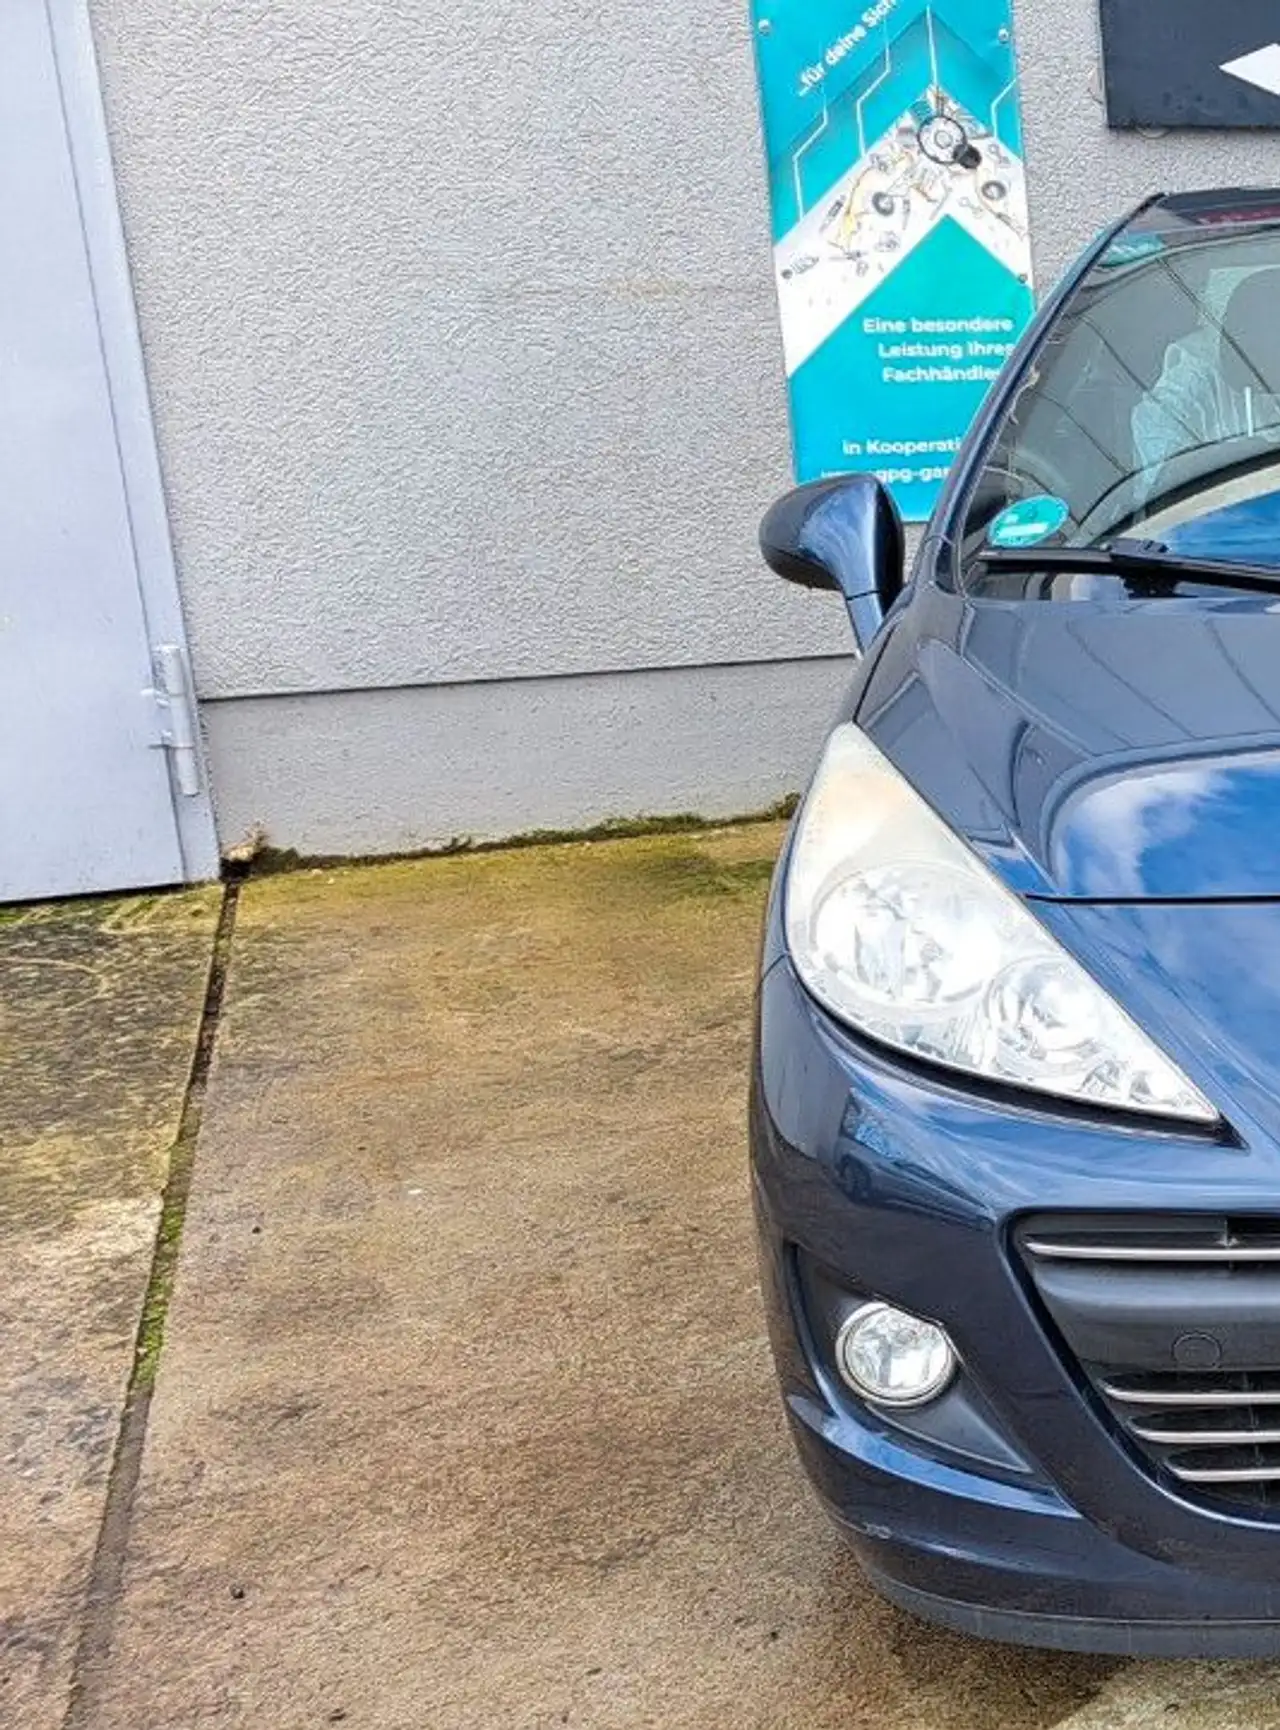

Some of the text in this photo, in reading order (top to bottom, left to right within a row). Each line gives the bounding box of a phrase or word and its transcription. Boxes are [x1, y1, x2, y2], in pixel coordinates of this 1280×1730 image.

[825, 23, 868, 66] deine
[863, 316, 1014, 333] Eine besondere
[878, 342, 963, 360] Leistung
